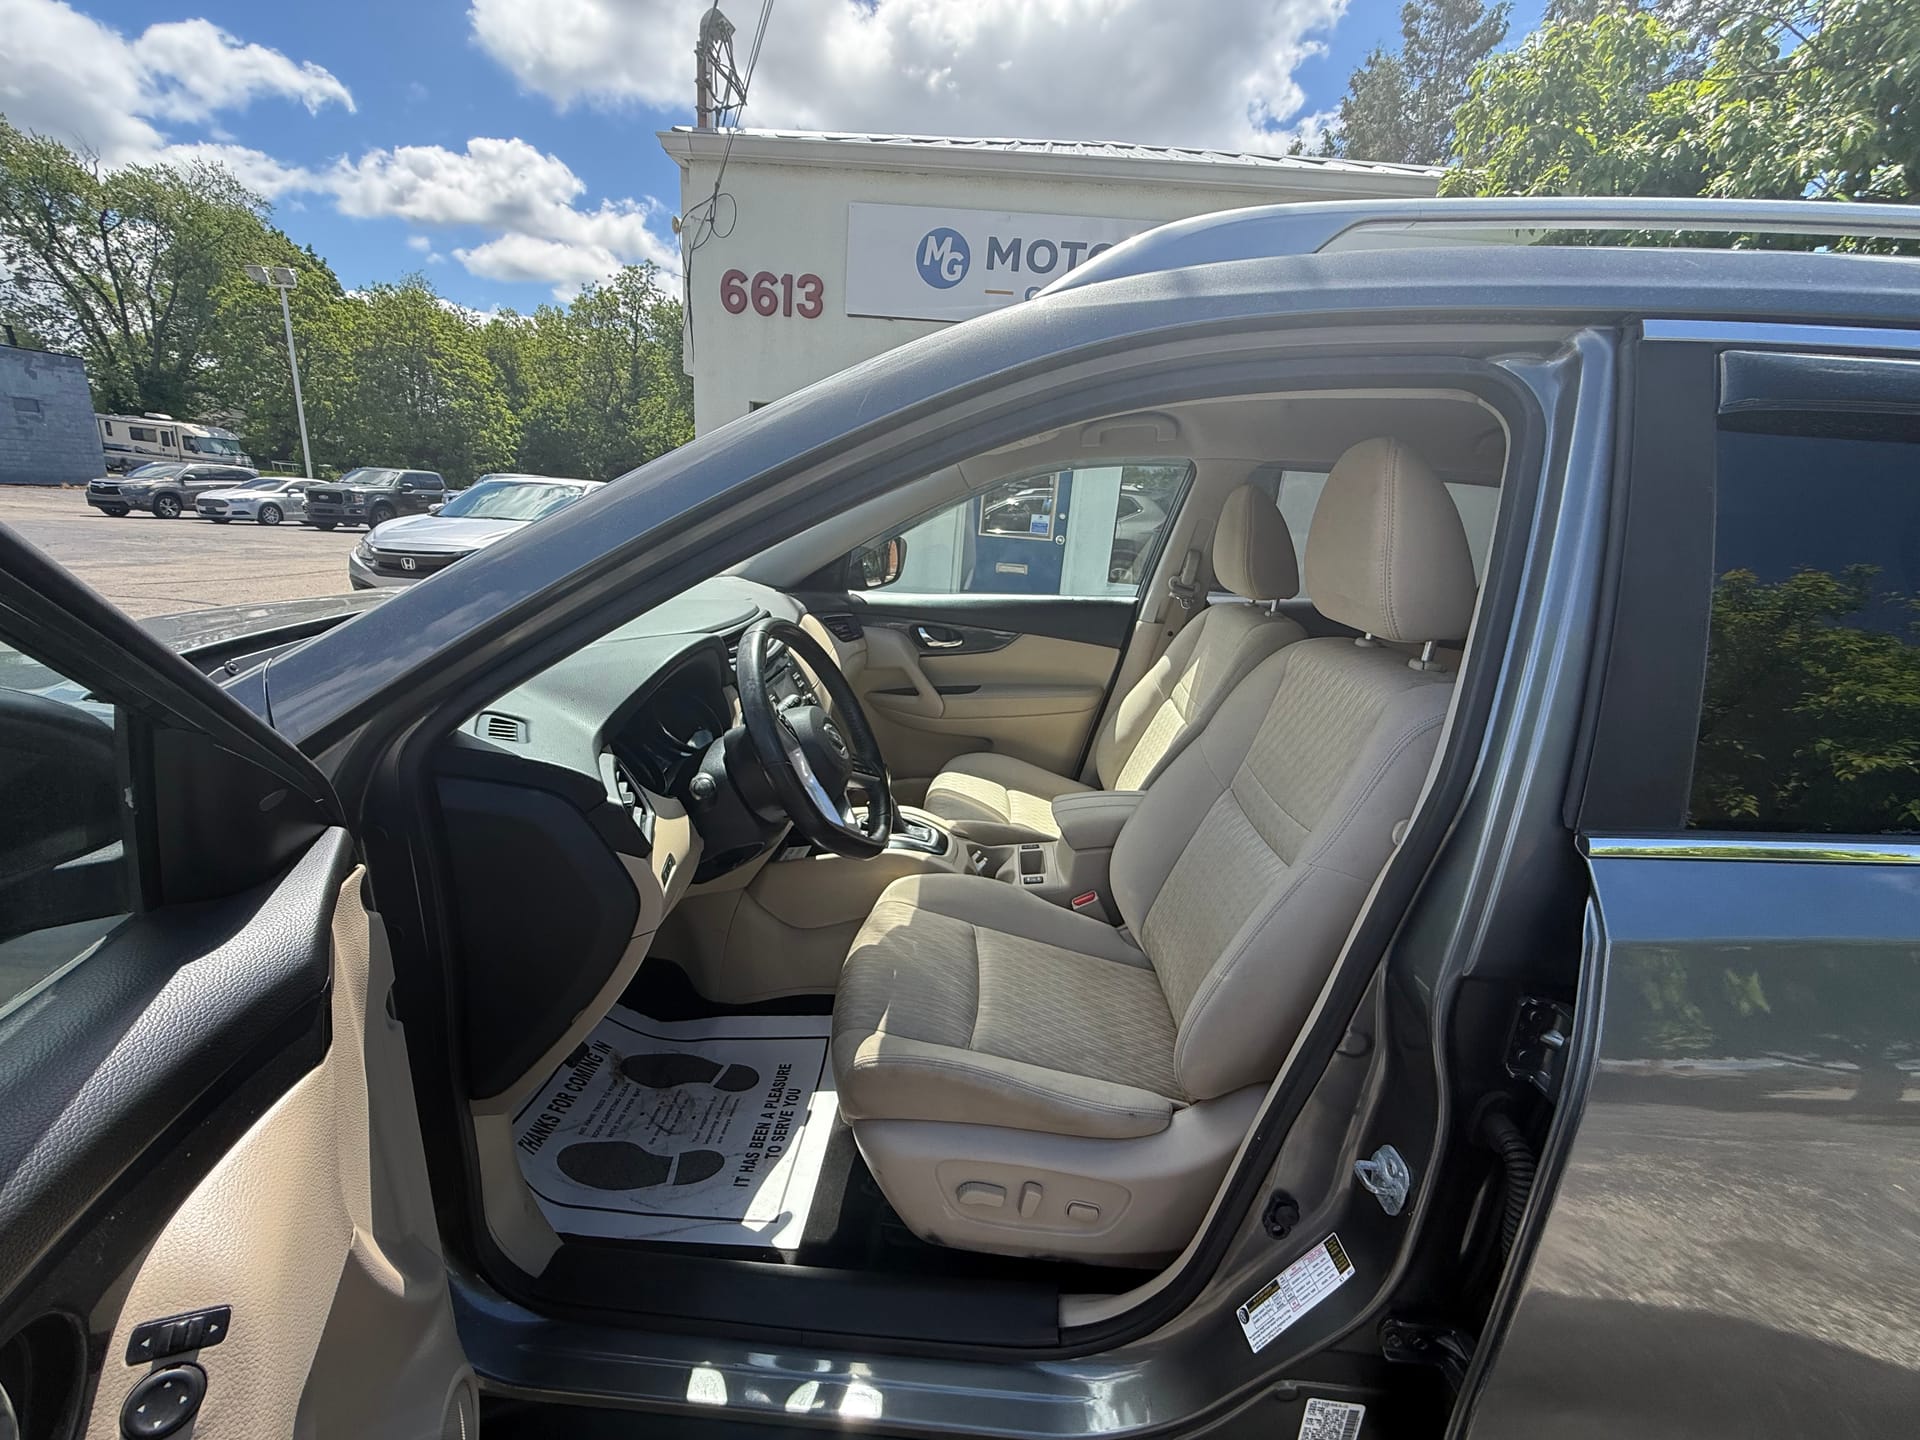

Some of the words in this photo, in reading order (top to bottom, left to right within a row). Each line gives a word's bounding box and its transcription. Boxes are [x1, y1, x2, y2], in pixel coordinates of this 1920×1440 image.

[922, 235, 964, 282] MG
[720, 268, 824, 319] 6613
[518, 1113, 560, 1155] THANKS
[547, 1092, 578, 1114] FOR
[564, 1053, 604, 1092] COMING
[592, 1040, 612, 1055] IN
[764, 1064, 792, 1109] PLEASURE
[783, 1088, 802, 1107] YOU
[760, 1111, 775, 1119] A
[771, 1110, 794, 1142] SERVE
[749, 1122, 771, 1149] BEEN
[739, 1152, 760, 1173] HAS
[765, 1145, 782, 1159] TO
[733, 1176, 750, 1187] IT
